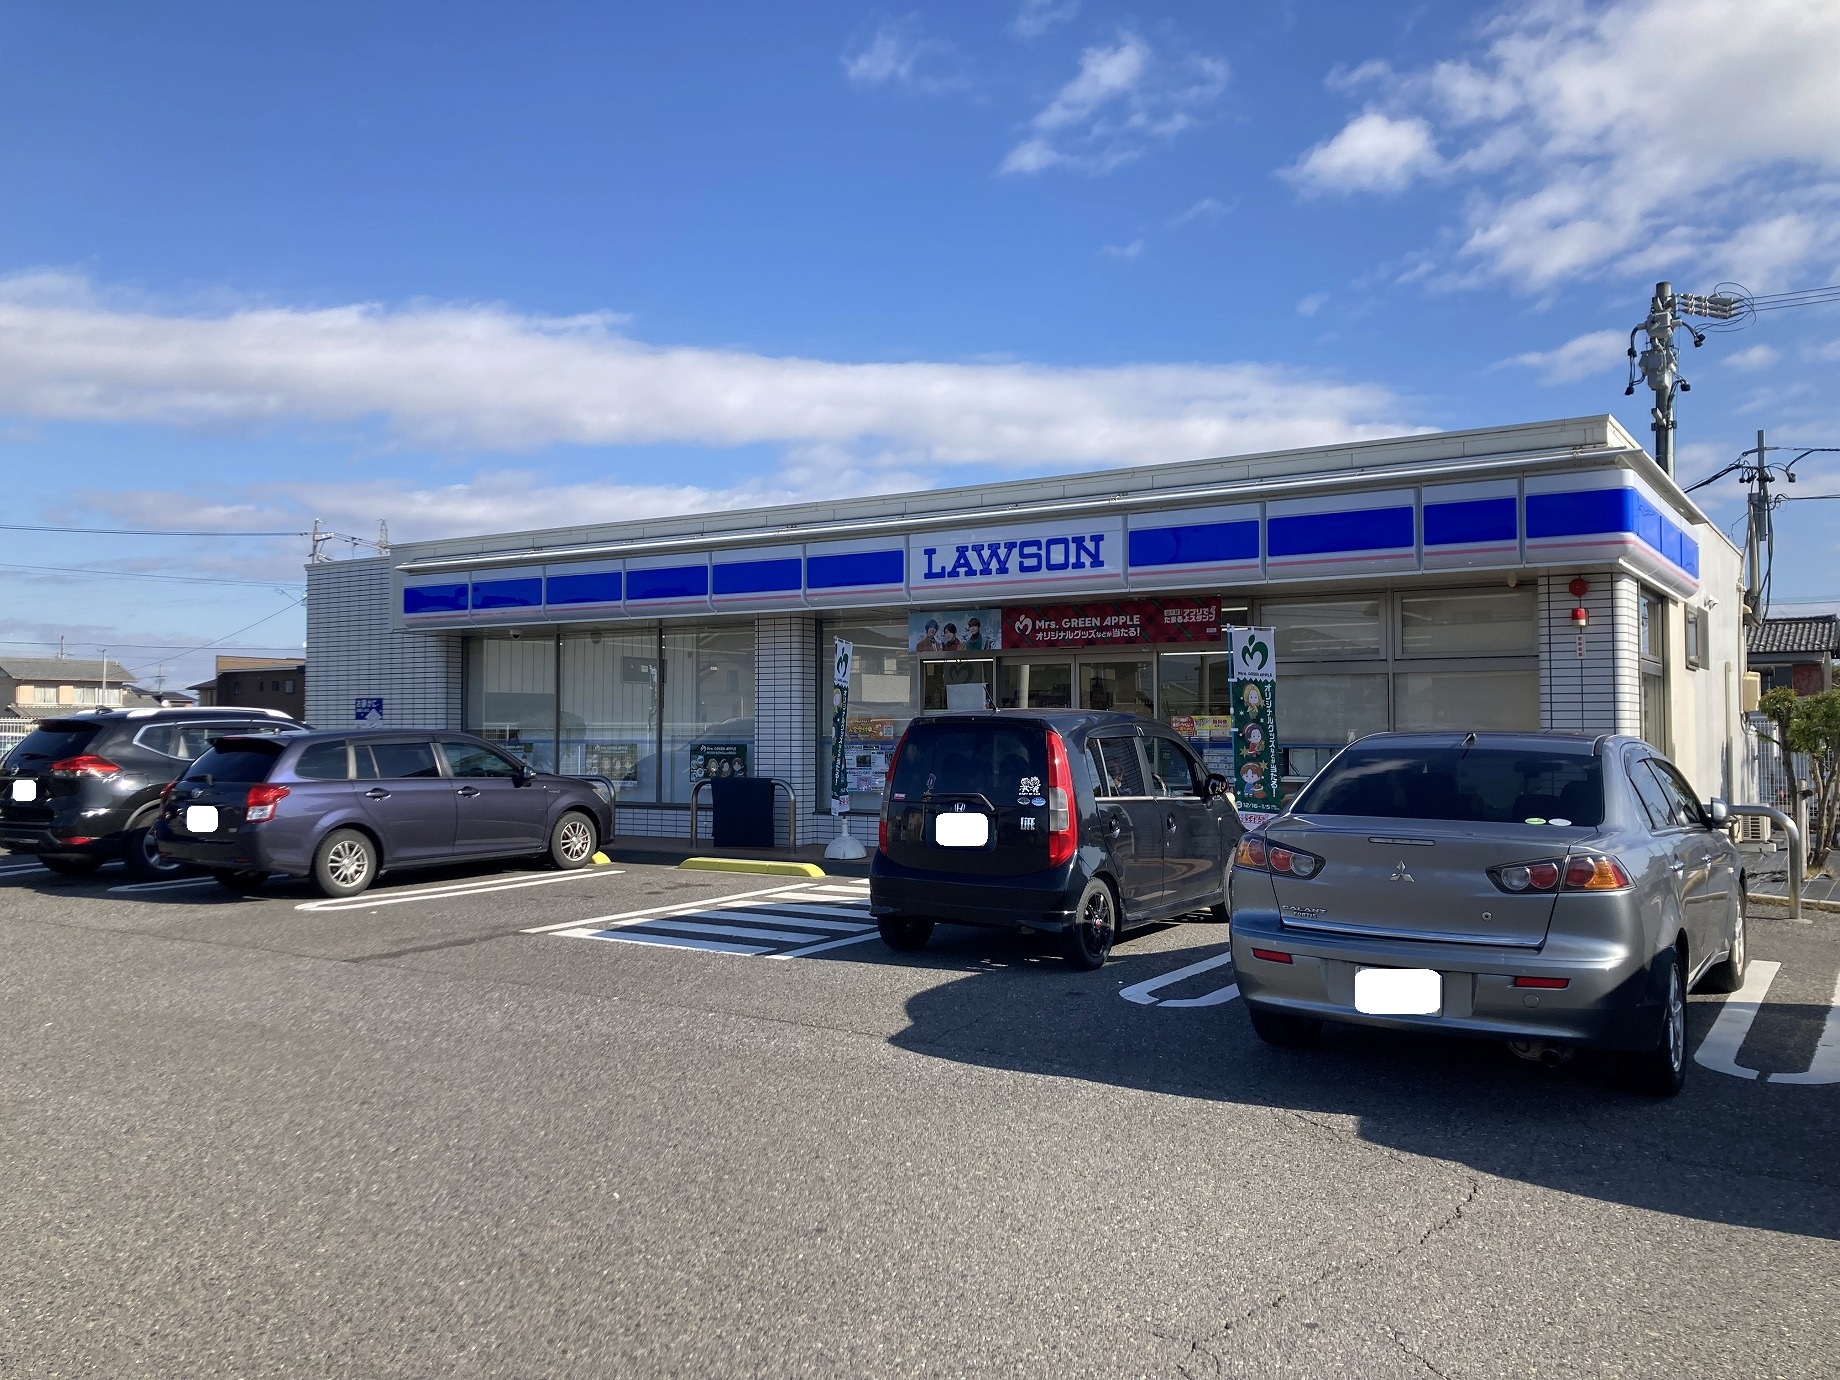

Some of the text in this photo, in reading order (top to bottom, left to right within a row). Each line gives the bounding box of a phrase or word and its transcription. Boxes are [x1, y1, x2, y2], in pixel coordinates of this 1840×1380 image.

[924, 535, 1104, 579] LAWSON
[1036, 614, 1141, 630] Mrs. GREEN APPLE
[1164, 614, 1215, 624] たまるよスタンプ
